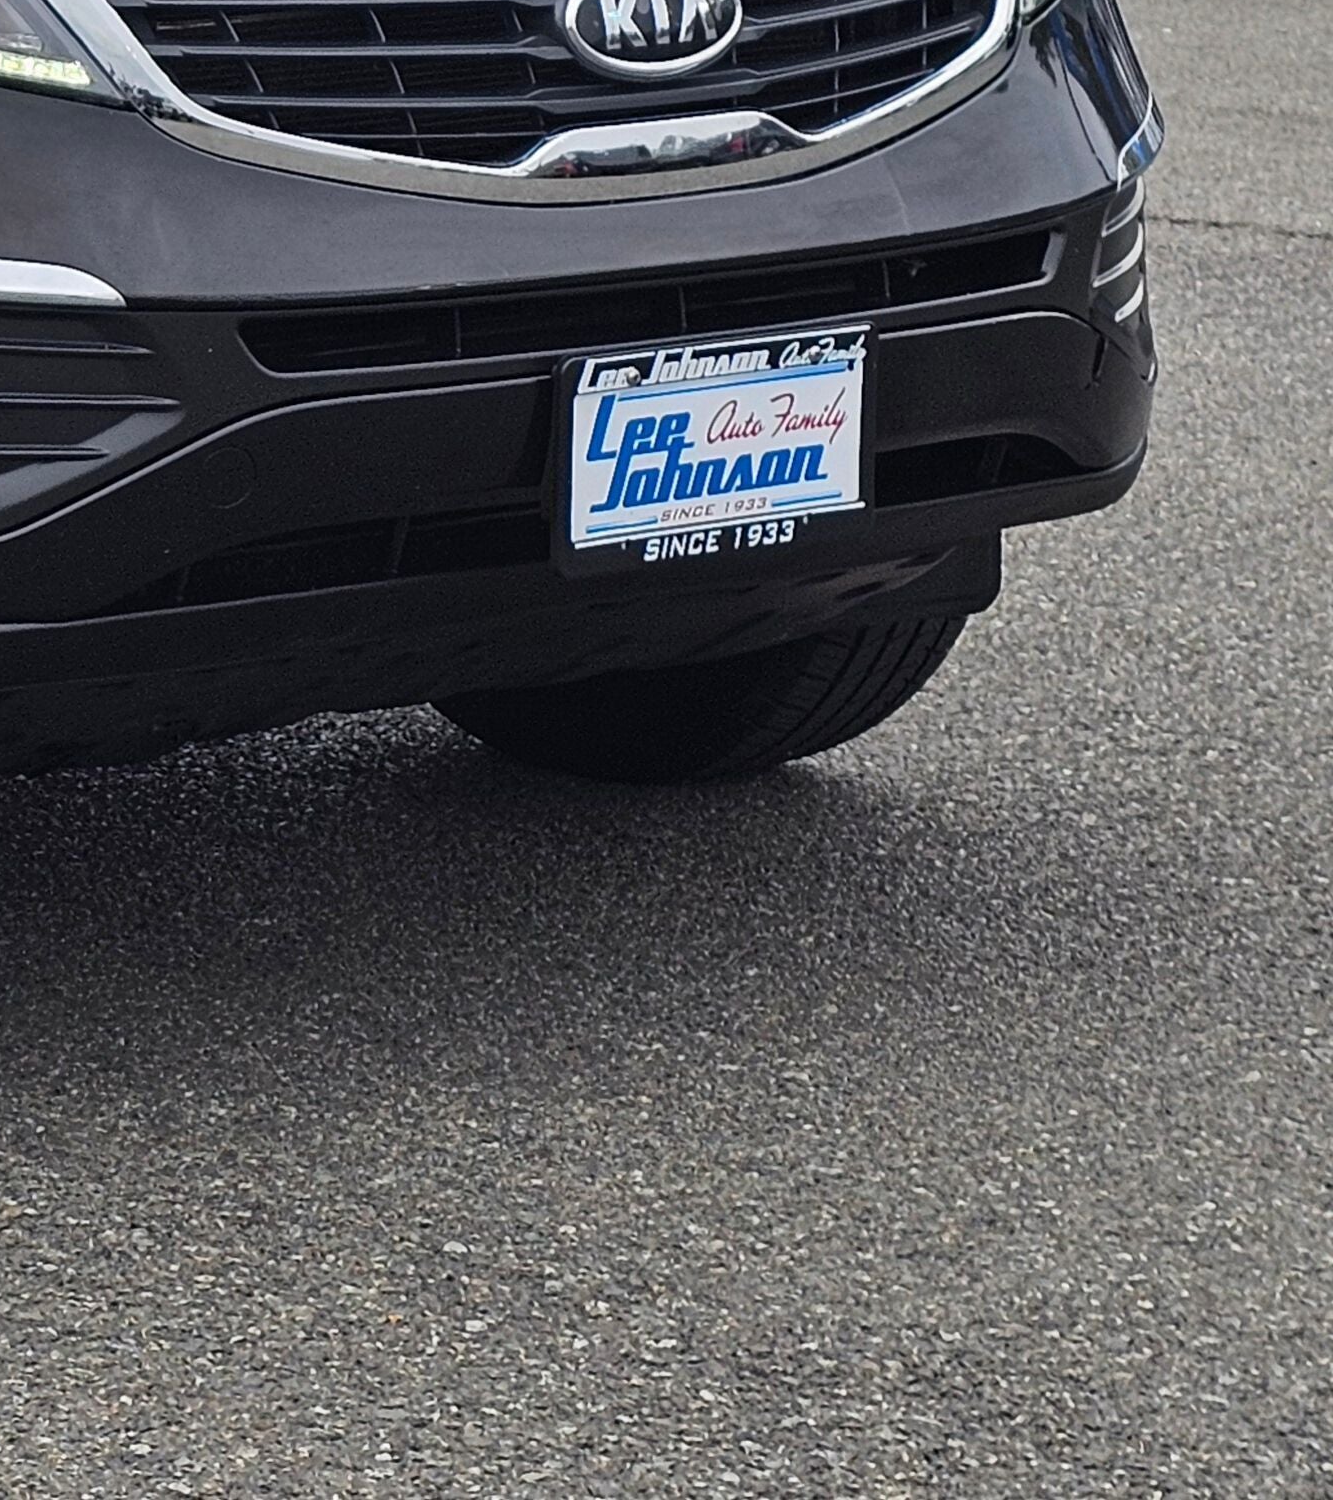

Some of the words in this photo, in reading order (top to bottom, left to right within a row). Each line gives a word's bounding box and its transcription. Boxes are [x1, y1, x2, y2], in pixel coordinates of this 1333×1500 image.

[641, 347, 772, 386] Johnson
[586, 394, 694, 461] Lee
[706, 400, 765, 444] Auto
[770, 387, 847, 444] Family
[589, 440, 828, 514] Johnson
[660, 504, 715, 522] SINCE
[725, 497, 768, 514] 1933
[643, 530, 722, 562] SINCE
[734, 520, 795, 550] 1933
